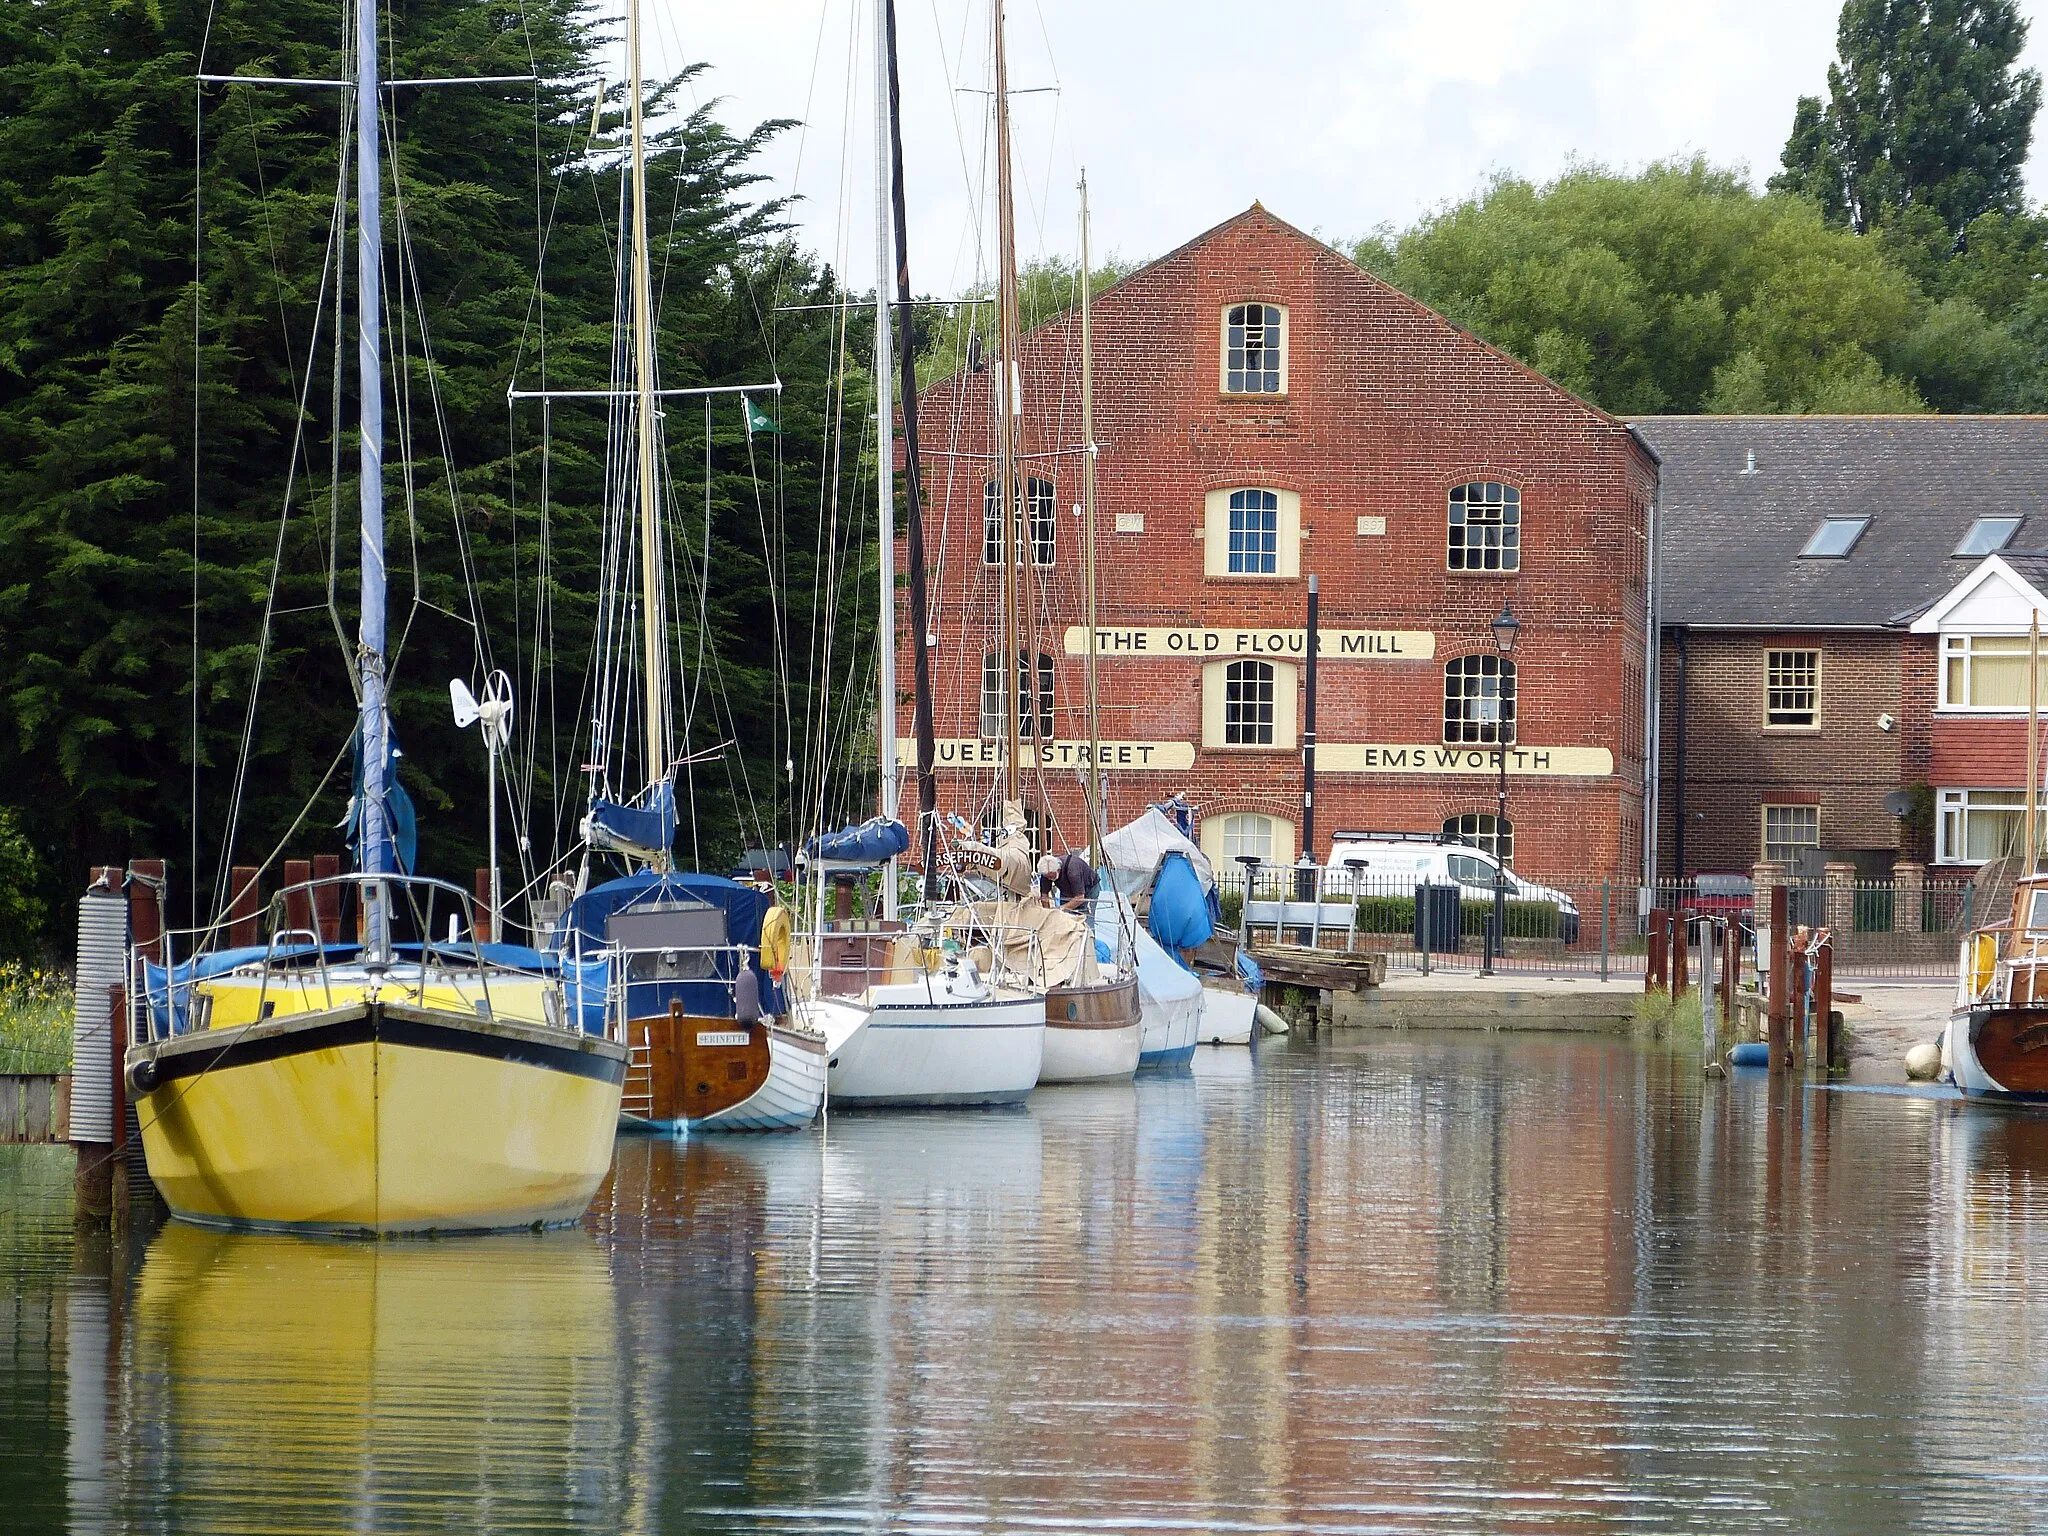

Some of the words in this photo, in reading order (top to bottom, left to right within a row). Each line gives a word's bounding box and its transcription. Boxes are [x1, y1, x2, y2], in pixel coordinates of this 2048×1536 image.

[1095, 632, 1147, 650] THE
[1167, 633, 1220, 651] OLD
[1341, 635, 1403, 653] MILL
[933, 743, 1008, 762] UEE
[1041, 745, 1155, 764] STREET
[1365, 748, 1550, 769] EMSWORTH
[920, 850, 998, 869] RSEPHONE
